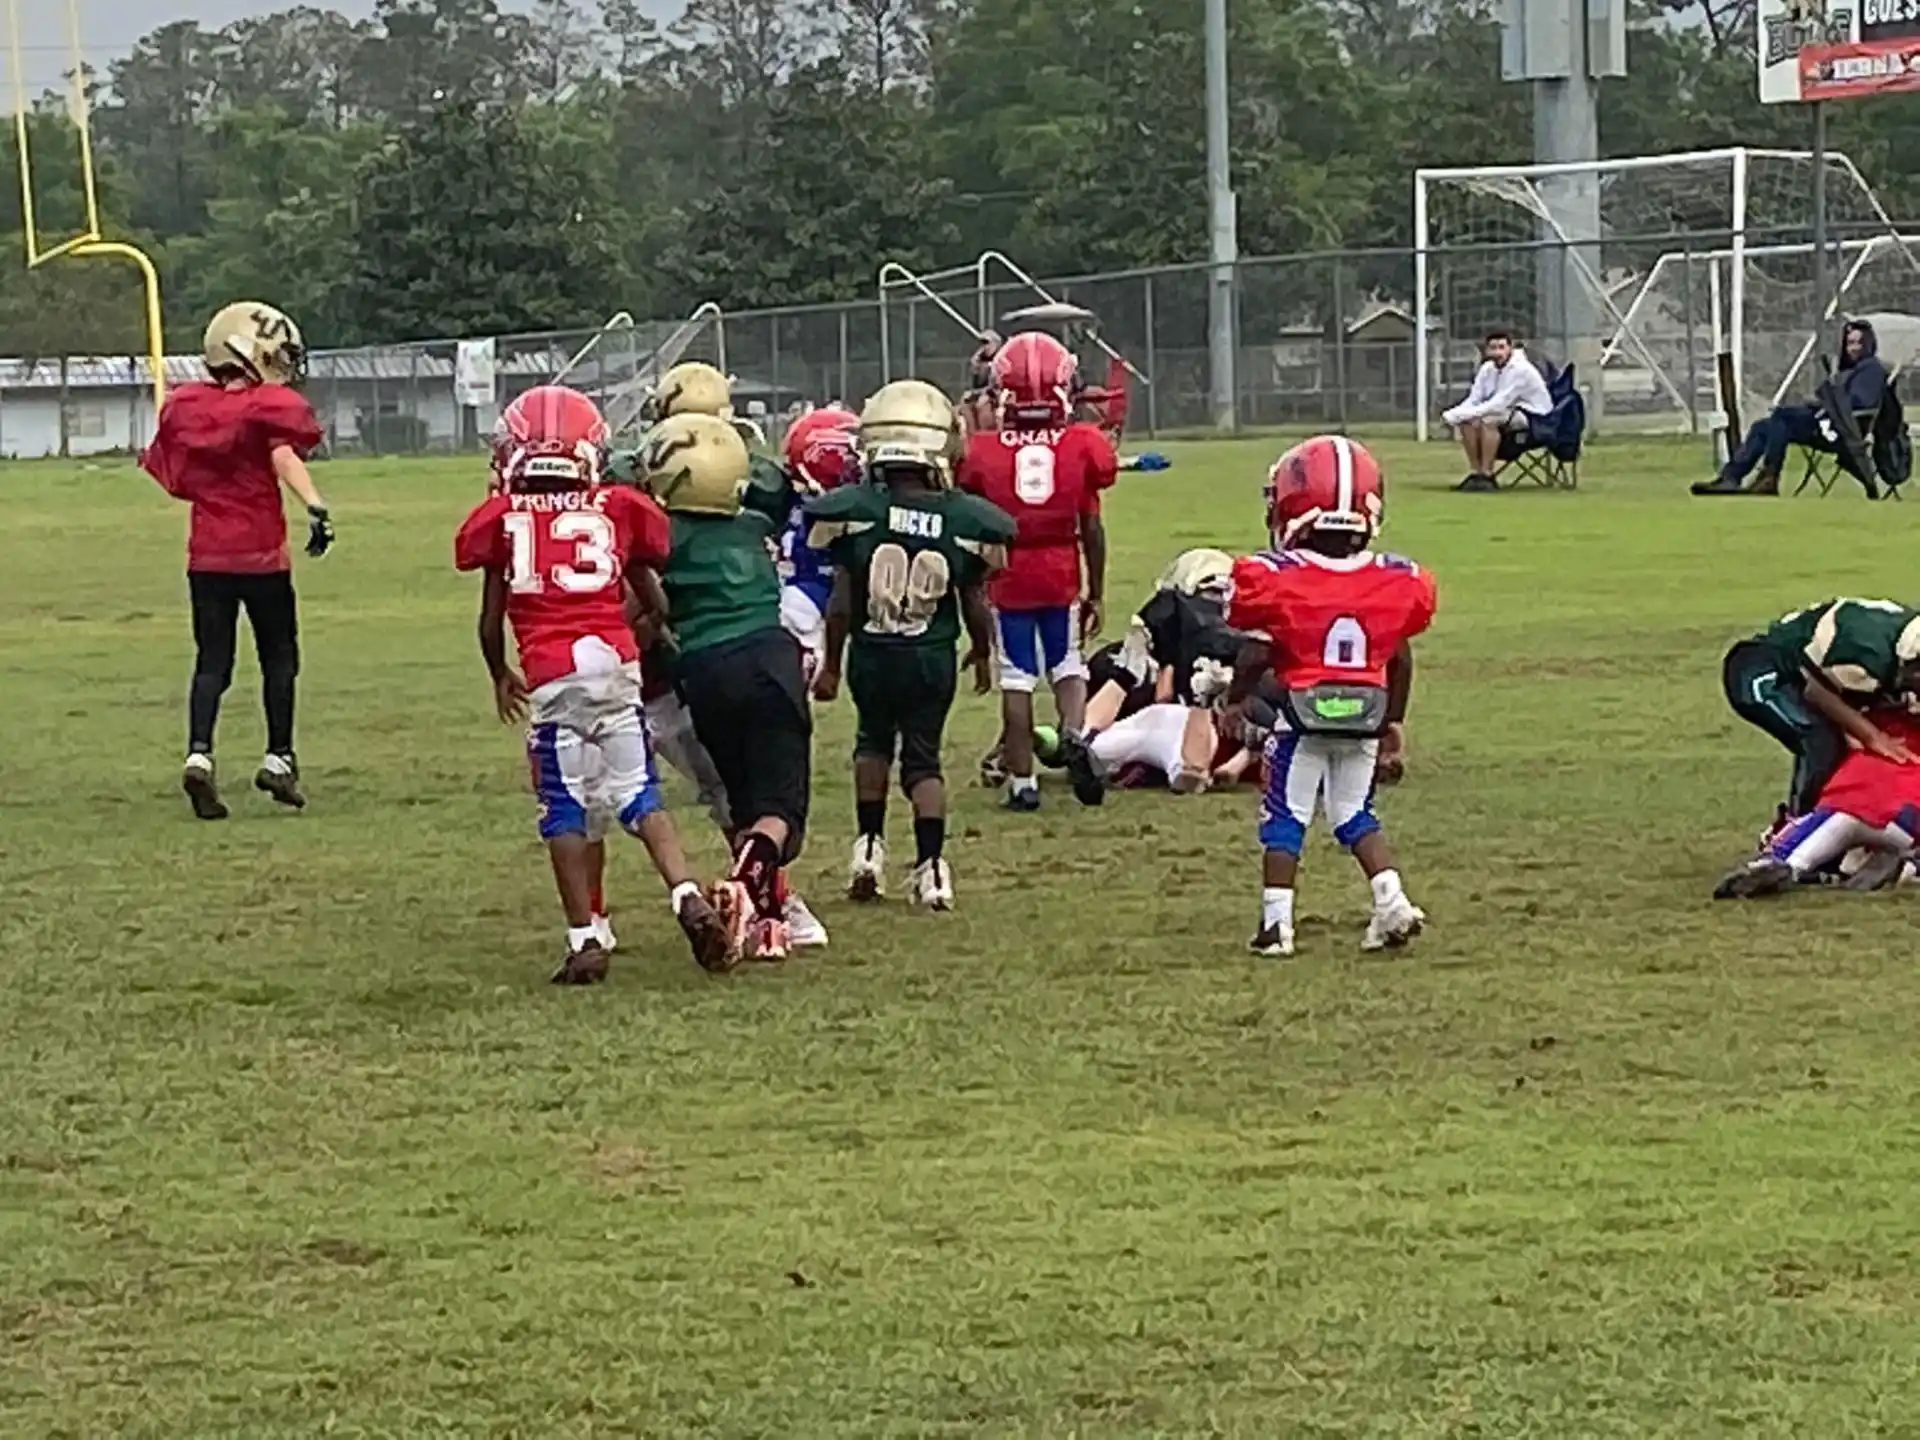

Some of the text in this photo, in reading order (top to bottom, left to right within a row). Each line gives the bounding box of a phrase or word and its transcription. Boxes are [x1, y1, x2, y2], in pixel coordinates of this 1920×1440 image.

[1864, 0, 1920, 24] GUES
[1015, 445, 1055, 505] 8
[510, 489, 612, 513] PRINGLE
[502, 511, 622, 594] 13
